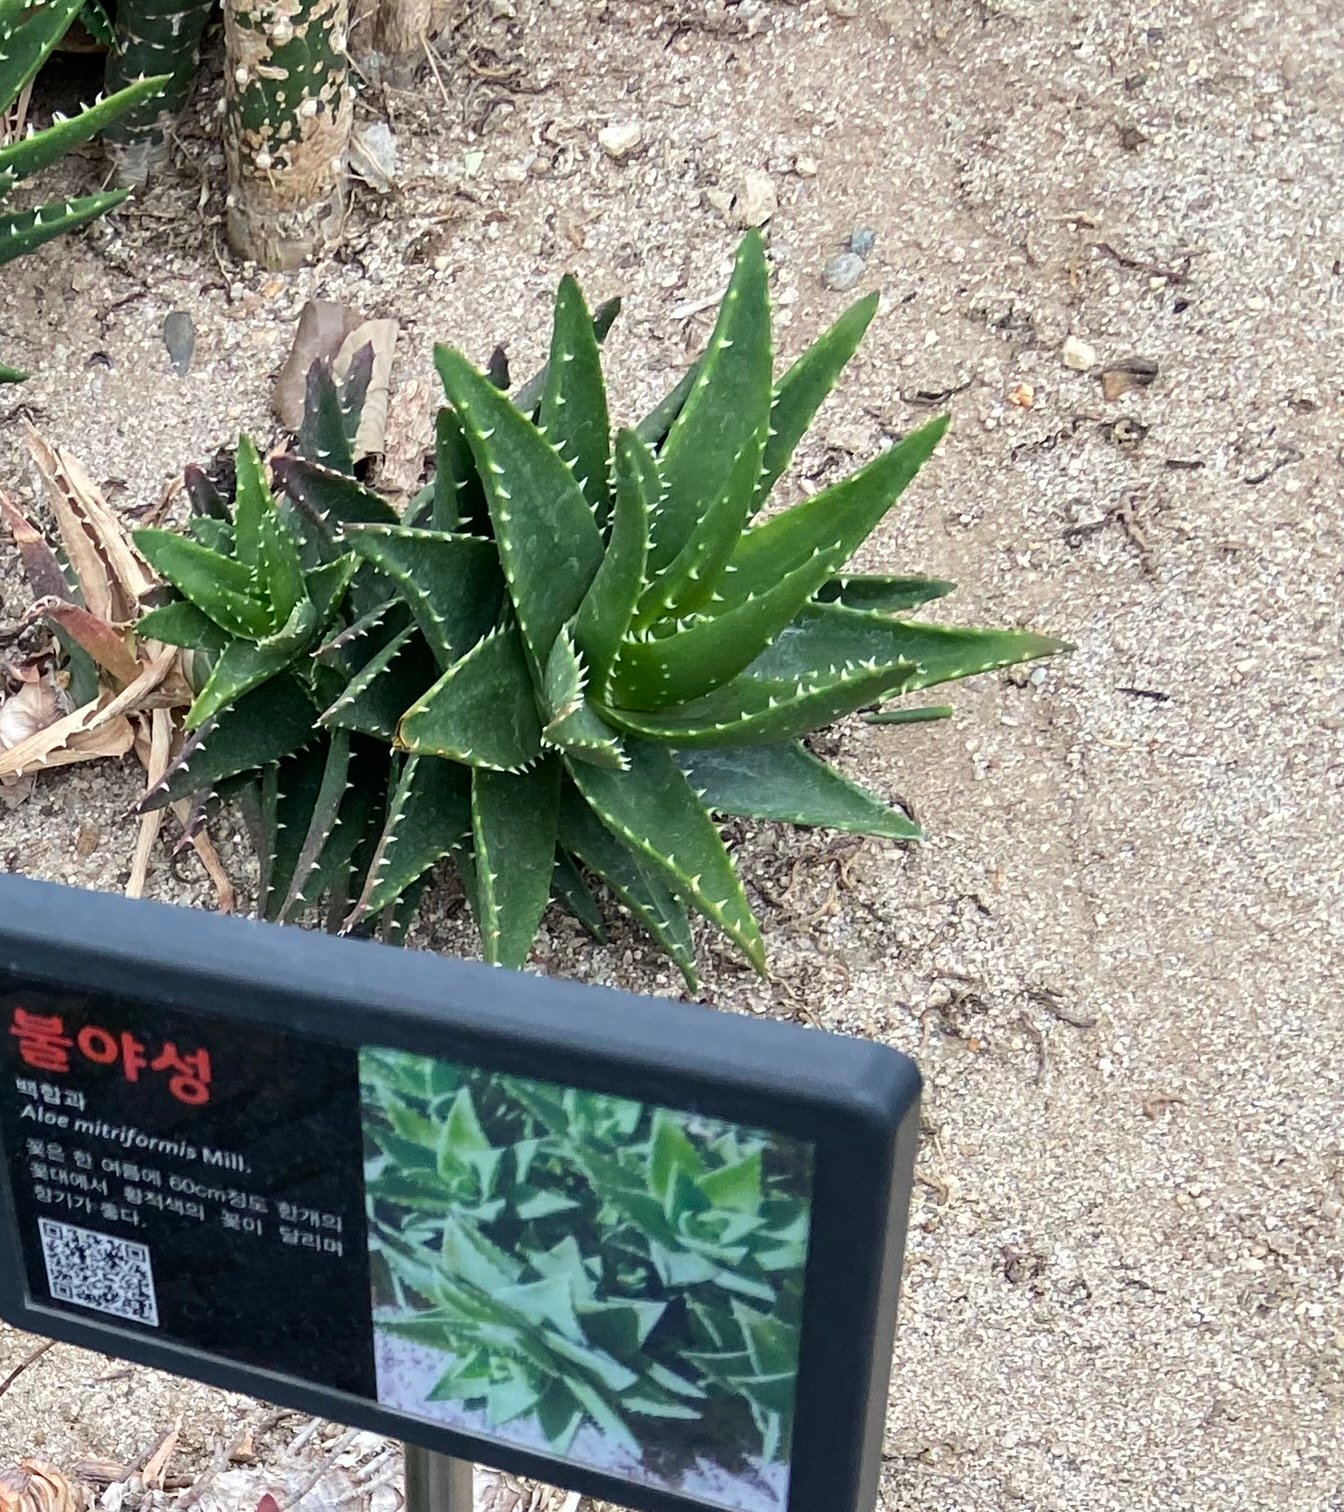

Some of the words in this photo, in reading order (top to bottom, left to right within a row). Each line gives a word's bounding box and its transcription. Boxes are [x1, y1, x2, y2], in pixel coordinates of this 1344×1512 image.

[9, 1006, 212, 1105] 불야성
[15, 1076, 86, 1112] 백합과
[20, 1103, 70, 1128] Aloe
[74, 1120, 198, 1160] mitriformis
[202, 1147, 252, 1174] Mill.
